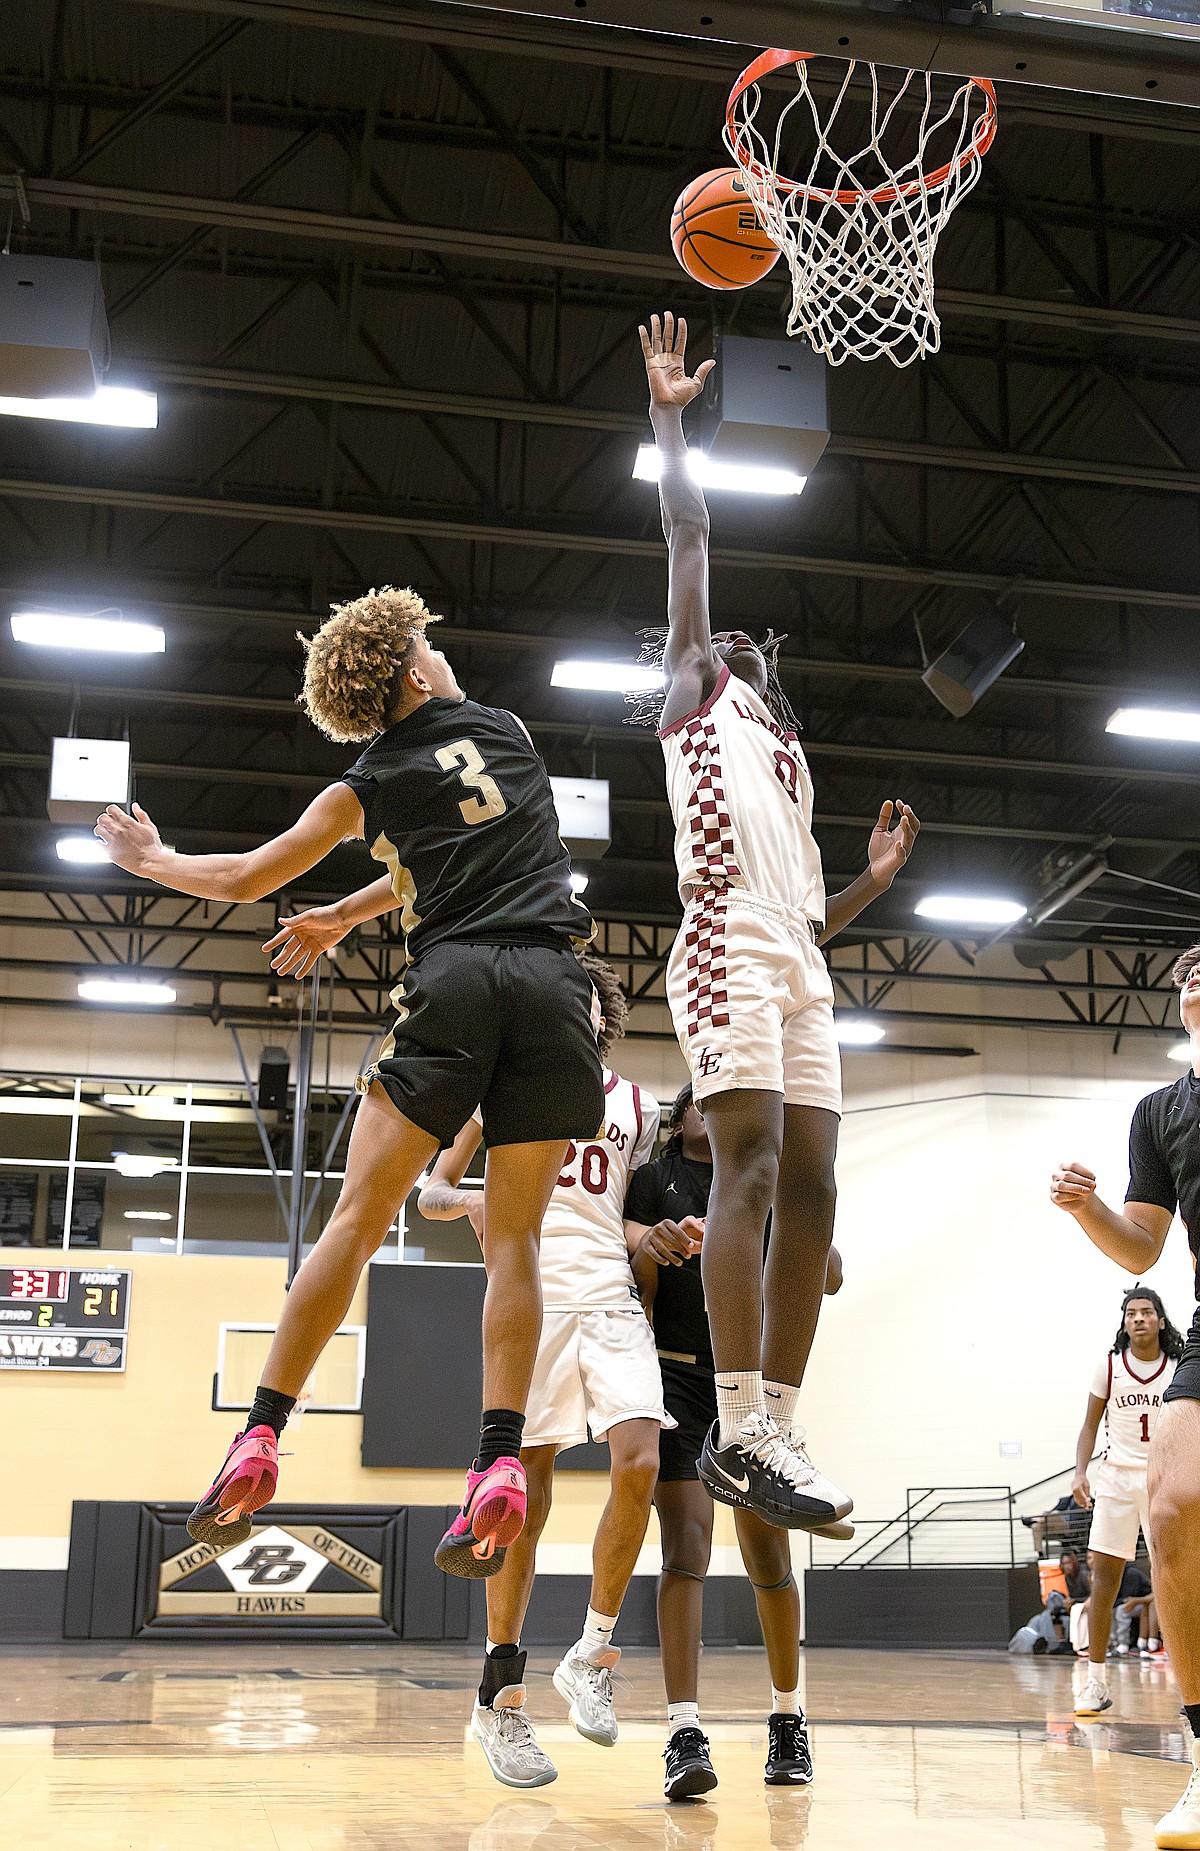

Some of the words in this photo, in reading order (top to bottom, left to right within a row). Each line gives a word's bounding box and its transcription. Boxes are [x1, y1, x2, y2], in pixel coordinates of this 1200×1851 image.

[434, 738, 508, 826] 3
[774, 750, 799, 804] 0
[606, 1122, 629, 1152] DS
[556, 1141, 609, 1195] 20
[11, 1270, 66, 1298] 3:31
[79, 1272, 122, 1285] HOME
[38, 1304, 54, 1327] 2
[83, 1287, 118, 1316] 21
[1115, 1393, 1160, 1409] LEOPAR
[1139, 1413, 1150, 1442] 1
[177, 1542, 223, 1573] HOM
[313, 1533, 338, 1553] OF
[337, 1547, 374, 1579] THE
[236, 1596, 306, 1612] HAWKS
